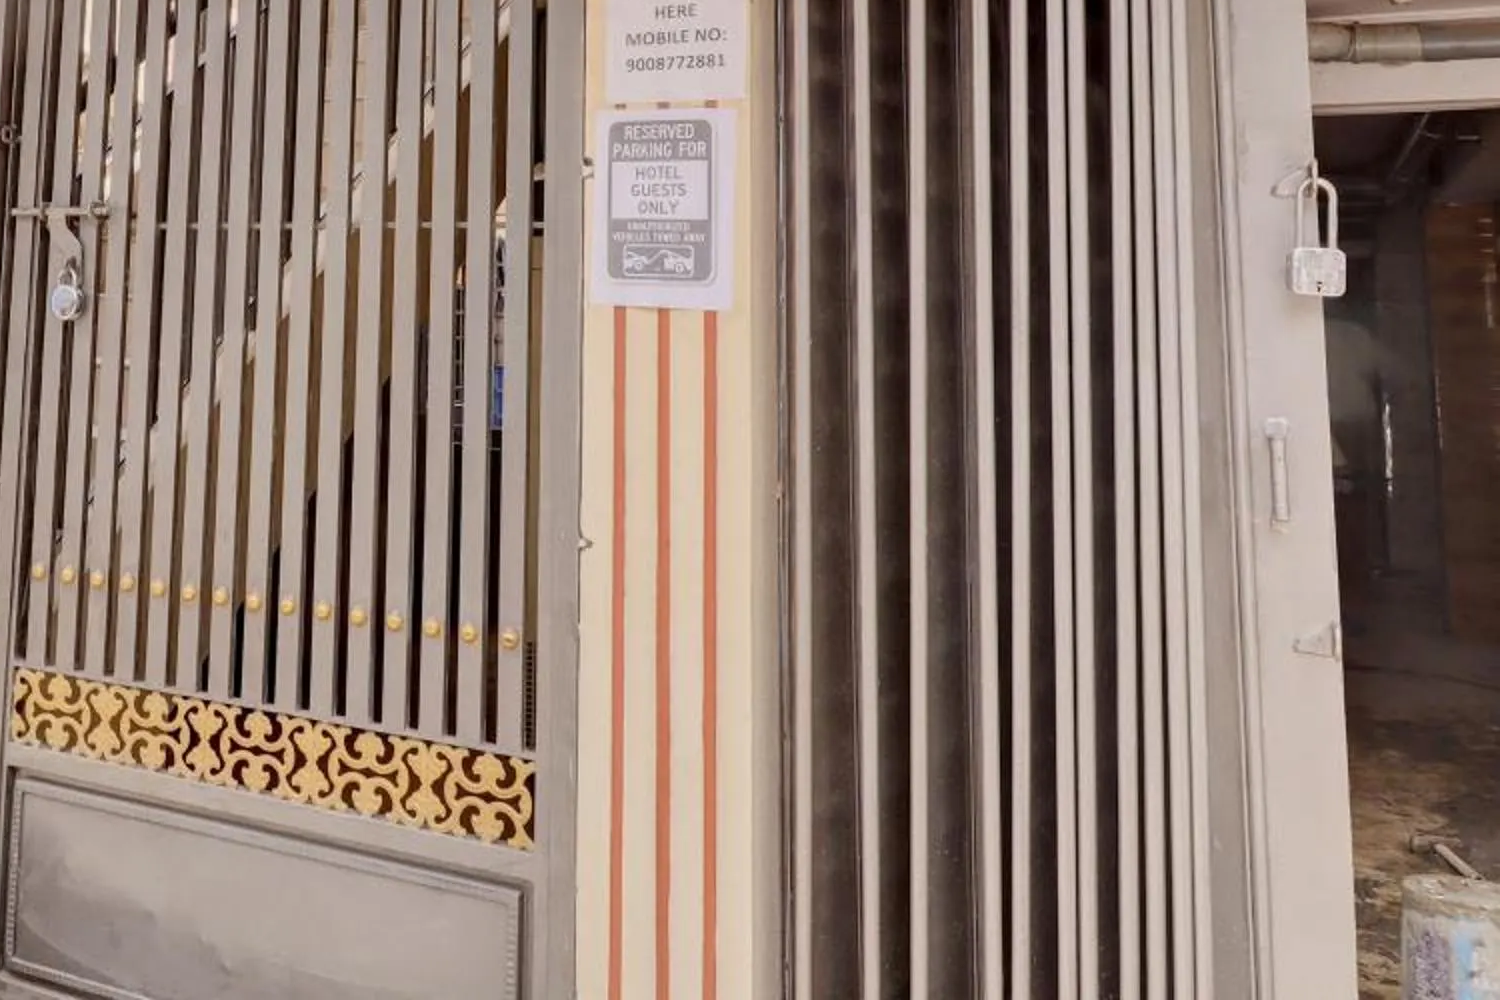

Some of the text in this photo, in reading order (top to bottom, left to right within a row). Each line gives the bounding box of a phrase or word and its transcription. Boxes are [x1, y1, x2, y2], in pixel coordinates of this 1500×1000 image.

[654, 3, 699, 20] HERE
[625, 27, 728, 47] MOBILE NO:
[625, 53, 725, 73] 9008772881
[623, 123, 695, 140] RESERVED
[612, 141, 707, 159] PARKING FOR
[635, 165, 683, 181] HOTEL
[631, 183, 687, 198] GUESTS
[637, 200, 680, 216] ONLY
